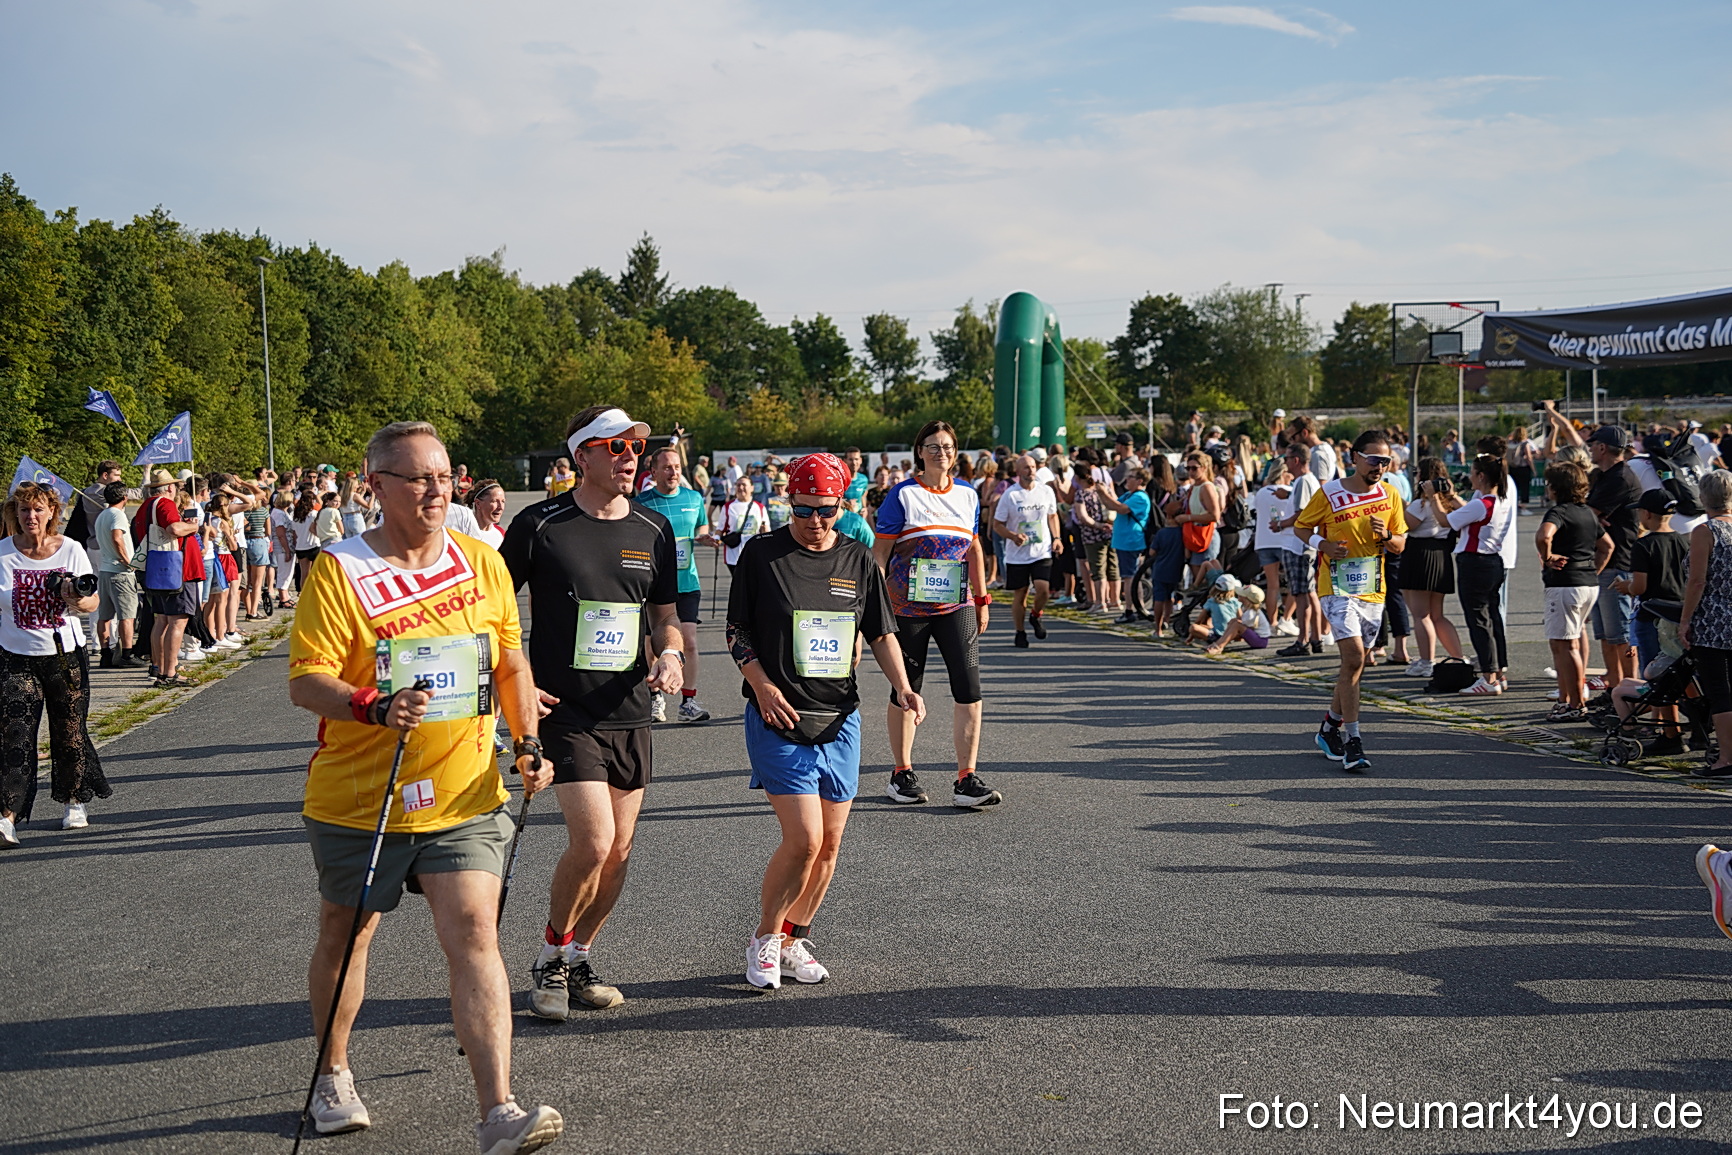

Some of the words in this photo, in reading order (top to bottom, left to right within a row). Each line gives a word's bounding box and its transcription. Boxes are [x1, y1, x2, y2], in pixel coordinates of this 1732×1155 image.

[1549, 330, 1587, 358] Hier
[1586, 325, 1665, 364] gewinnt
[1665, 321, 1708, 352] das
[1710, 316, 1732, 348] M
[1334, 510, 1361, 524] MAX
[1362, 503, 1391, 516] BÖGL
[925, 577, 950, 587] 1994
[1345, 572, 1368, 581] 1683
[374, 609, 432, 640] MAX
[433, 587, 486, 619] BÖGL
[595, 630, 625, 645] 247
[810, 639, 839, 653] 243
[429, 691, 477, 701] aerenfaenger
